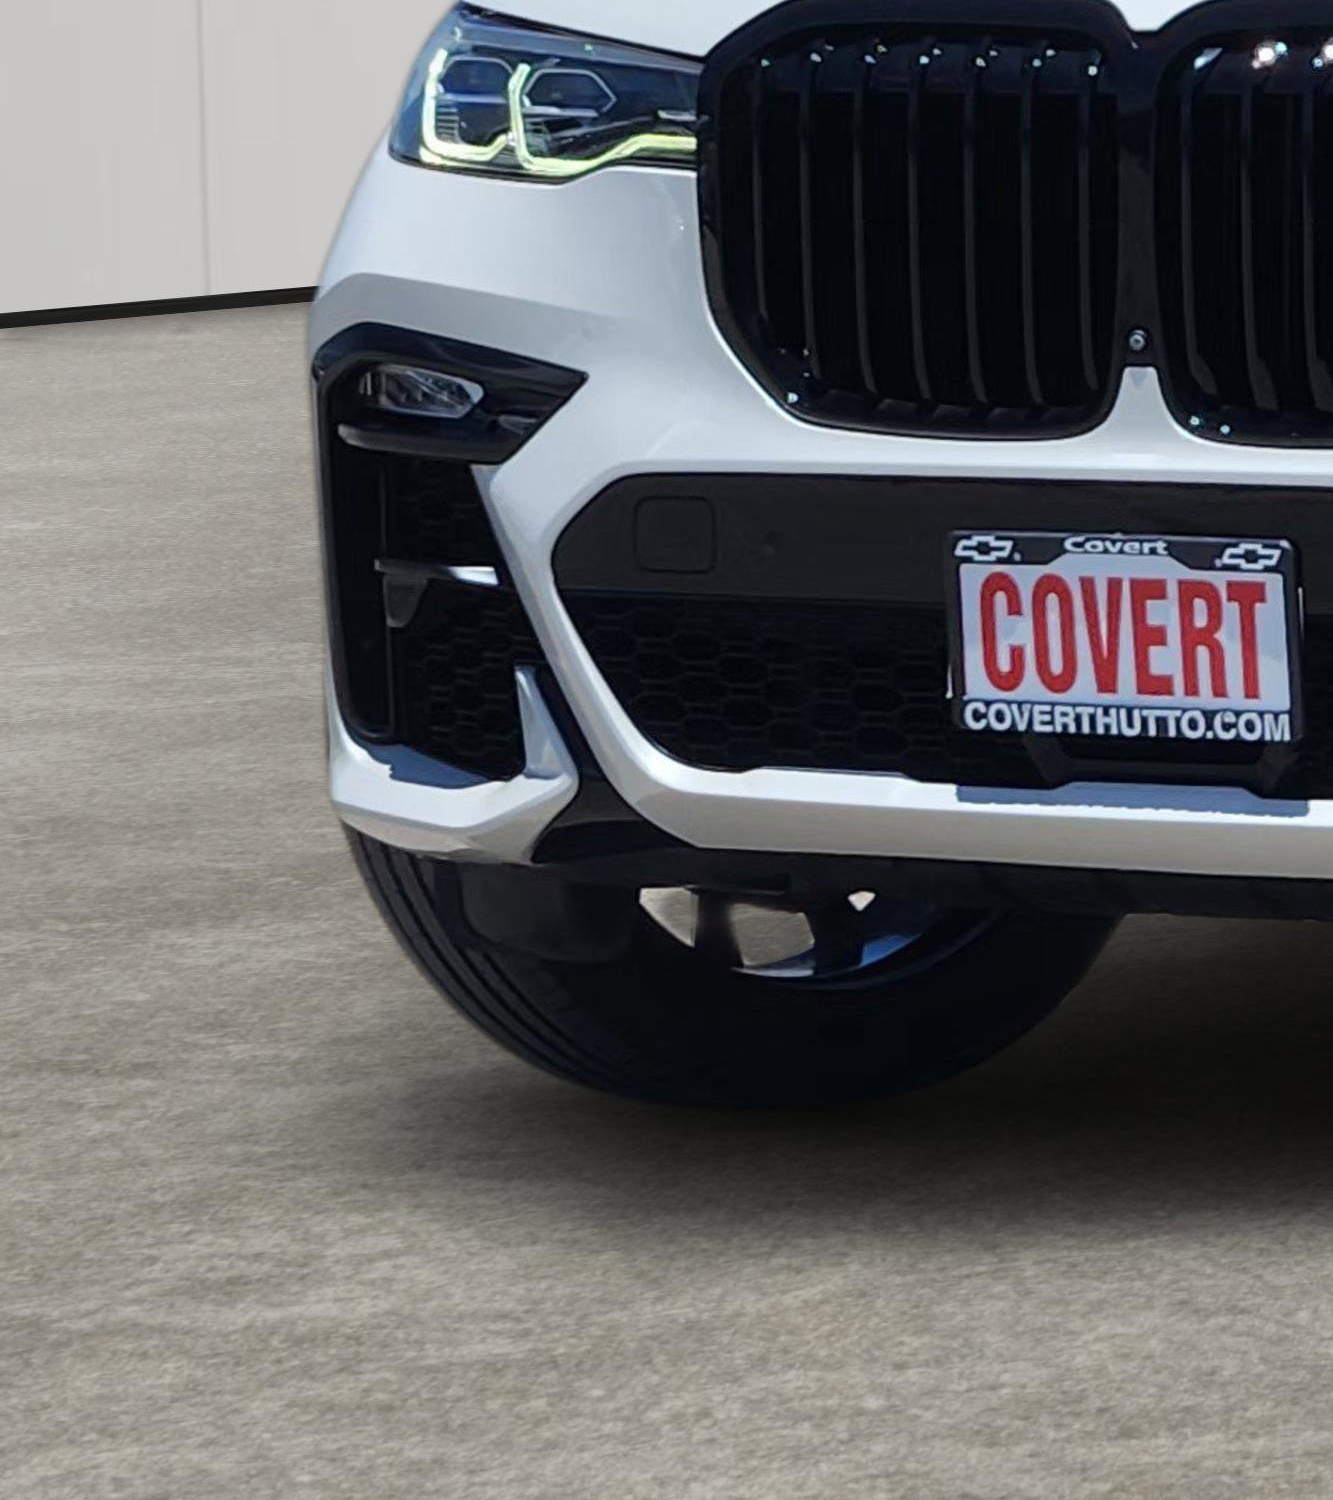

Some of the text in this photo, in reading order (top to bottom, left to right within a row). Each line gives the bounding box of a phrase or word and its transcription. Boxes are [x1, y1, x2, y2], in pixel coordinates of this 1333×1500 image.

[1063, 536, 1169, 556] Covert
[979, 571, 1268, 700] COVERT
[963, 701, 1292, 742] COVERTHUTTO.COM
